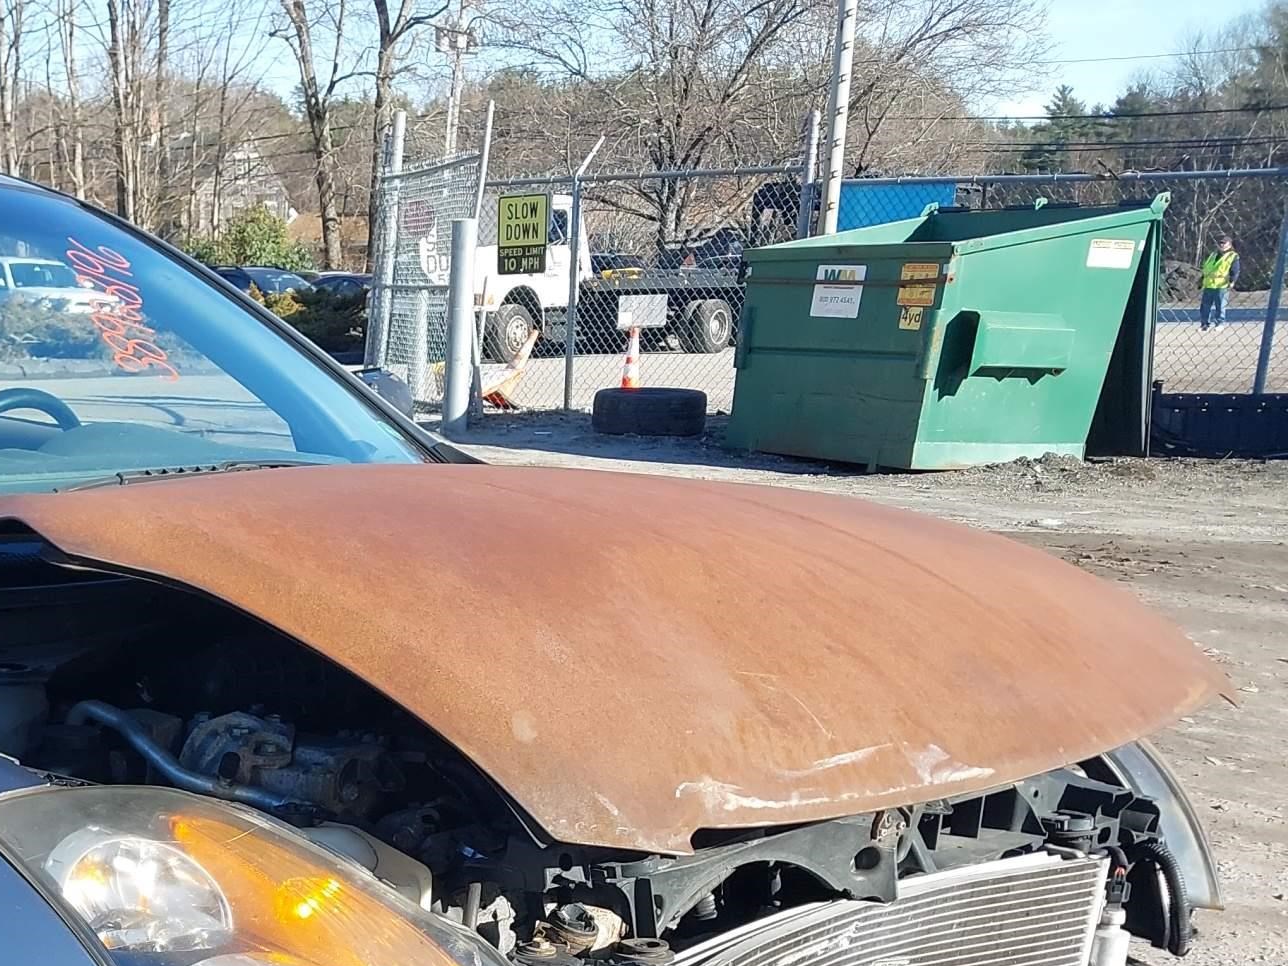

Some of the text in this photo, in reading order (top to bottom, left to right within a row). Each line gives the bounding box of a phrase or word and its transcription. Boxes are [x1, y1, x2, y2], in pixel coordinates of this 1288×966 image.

[507, 202, 539, 220] SLOW
[506, 223, 539, 240] DOWN
[500, 247, 544, 257] SPEED LIMIT
[504, 258, 540, 271] 10 MPH
[902, 310, 922, 325] 4yd
